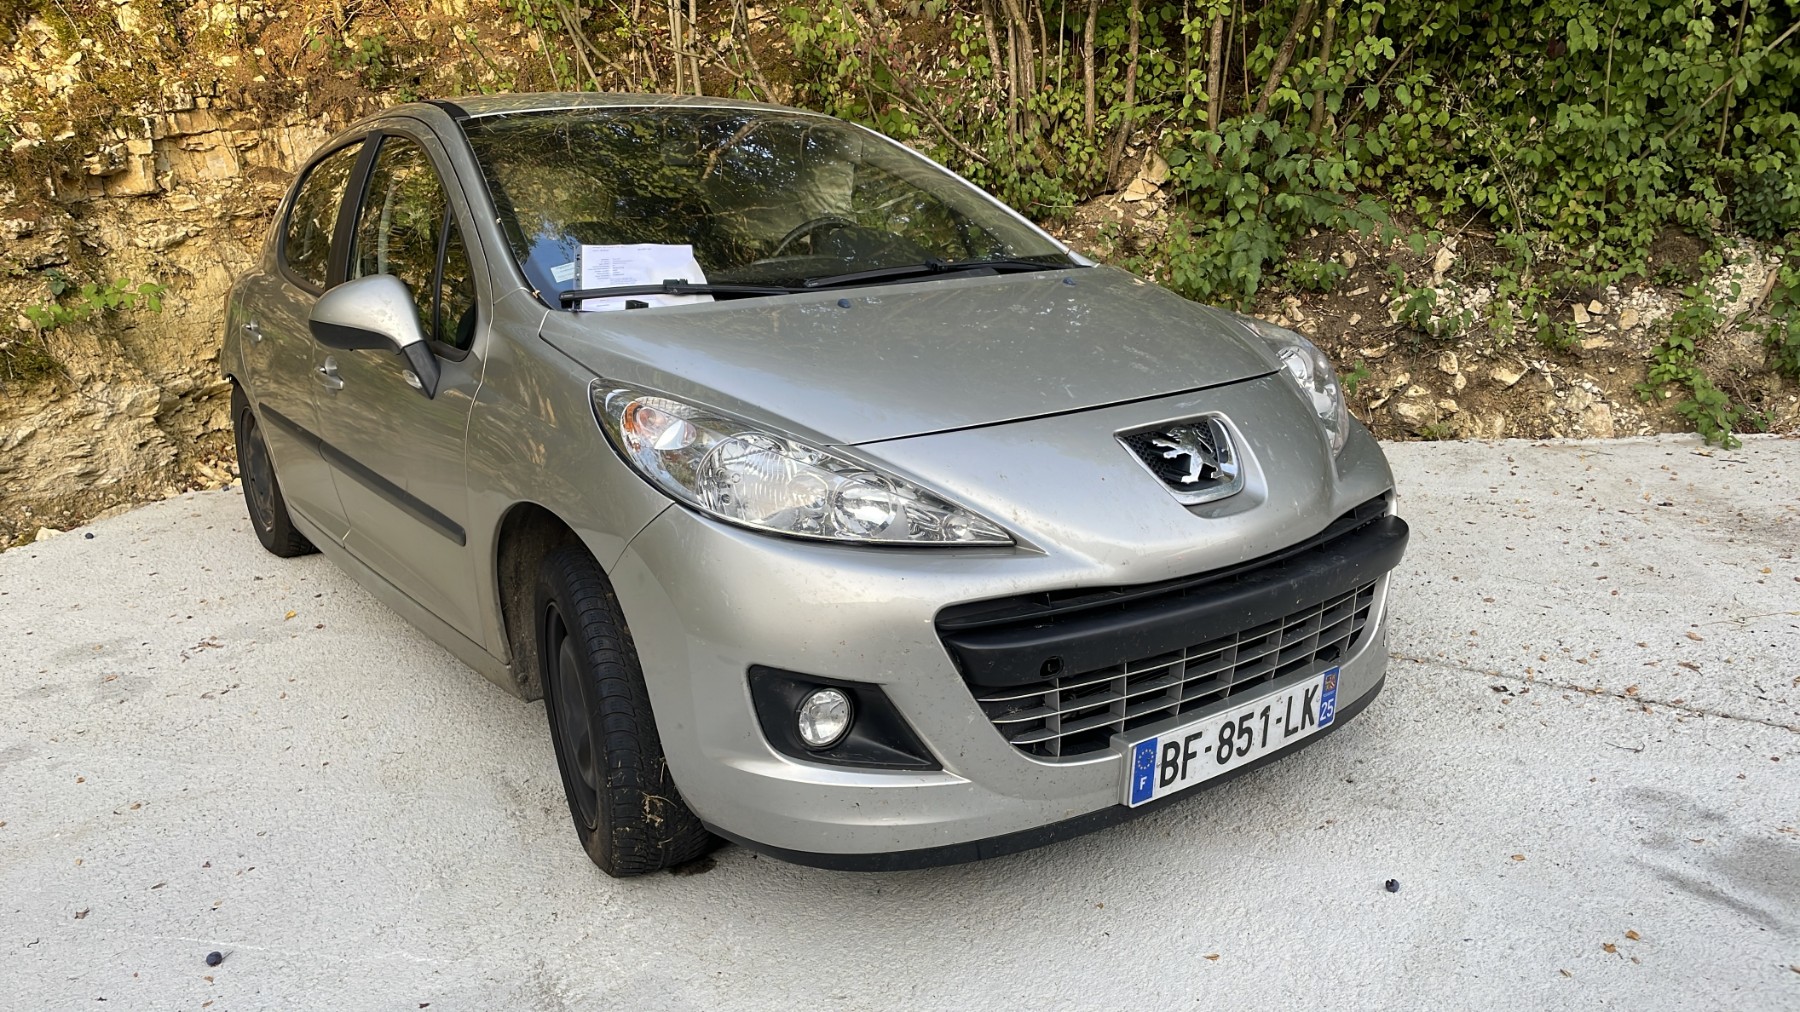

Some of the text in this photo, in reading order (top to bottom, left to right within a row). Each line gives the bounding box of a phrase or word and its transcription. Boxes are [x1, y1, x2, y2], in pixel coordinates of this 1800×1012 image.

[1319, 698, 1335, 722] 25
[1159, 684, 1320, 789] BF-851-LK
[1139, 776, 1148, 791] F
